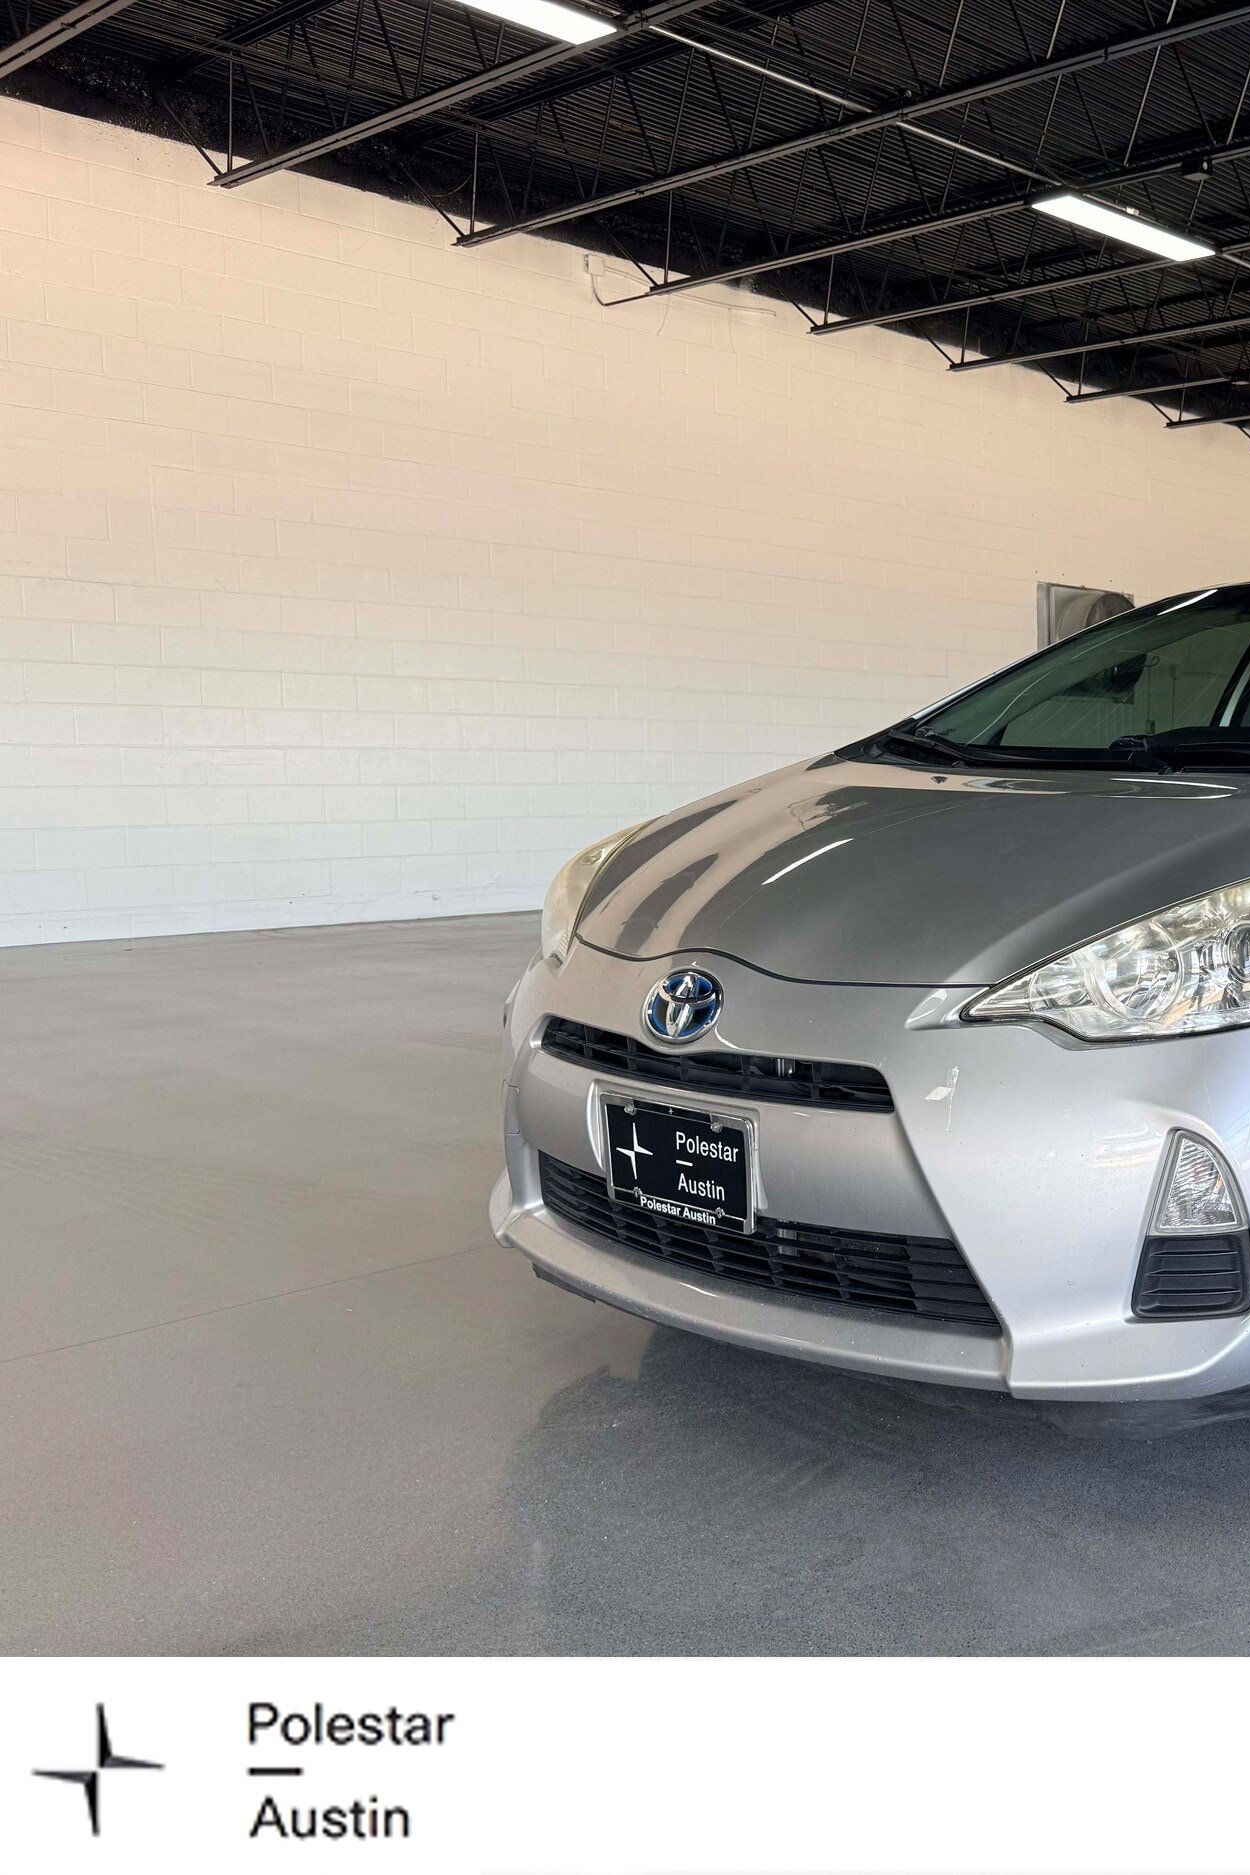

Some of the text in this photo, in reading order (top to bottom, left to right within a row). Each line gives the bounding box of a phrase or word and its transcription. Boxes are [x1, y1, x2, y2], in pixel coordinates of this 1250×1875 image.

[675, 1131, 739, 1163] Polestar
[677, 1172, 726, 1201] Austin
[640, 1196, 716, 1226] Polestar Austin
